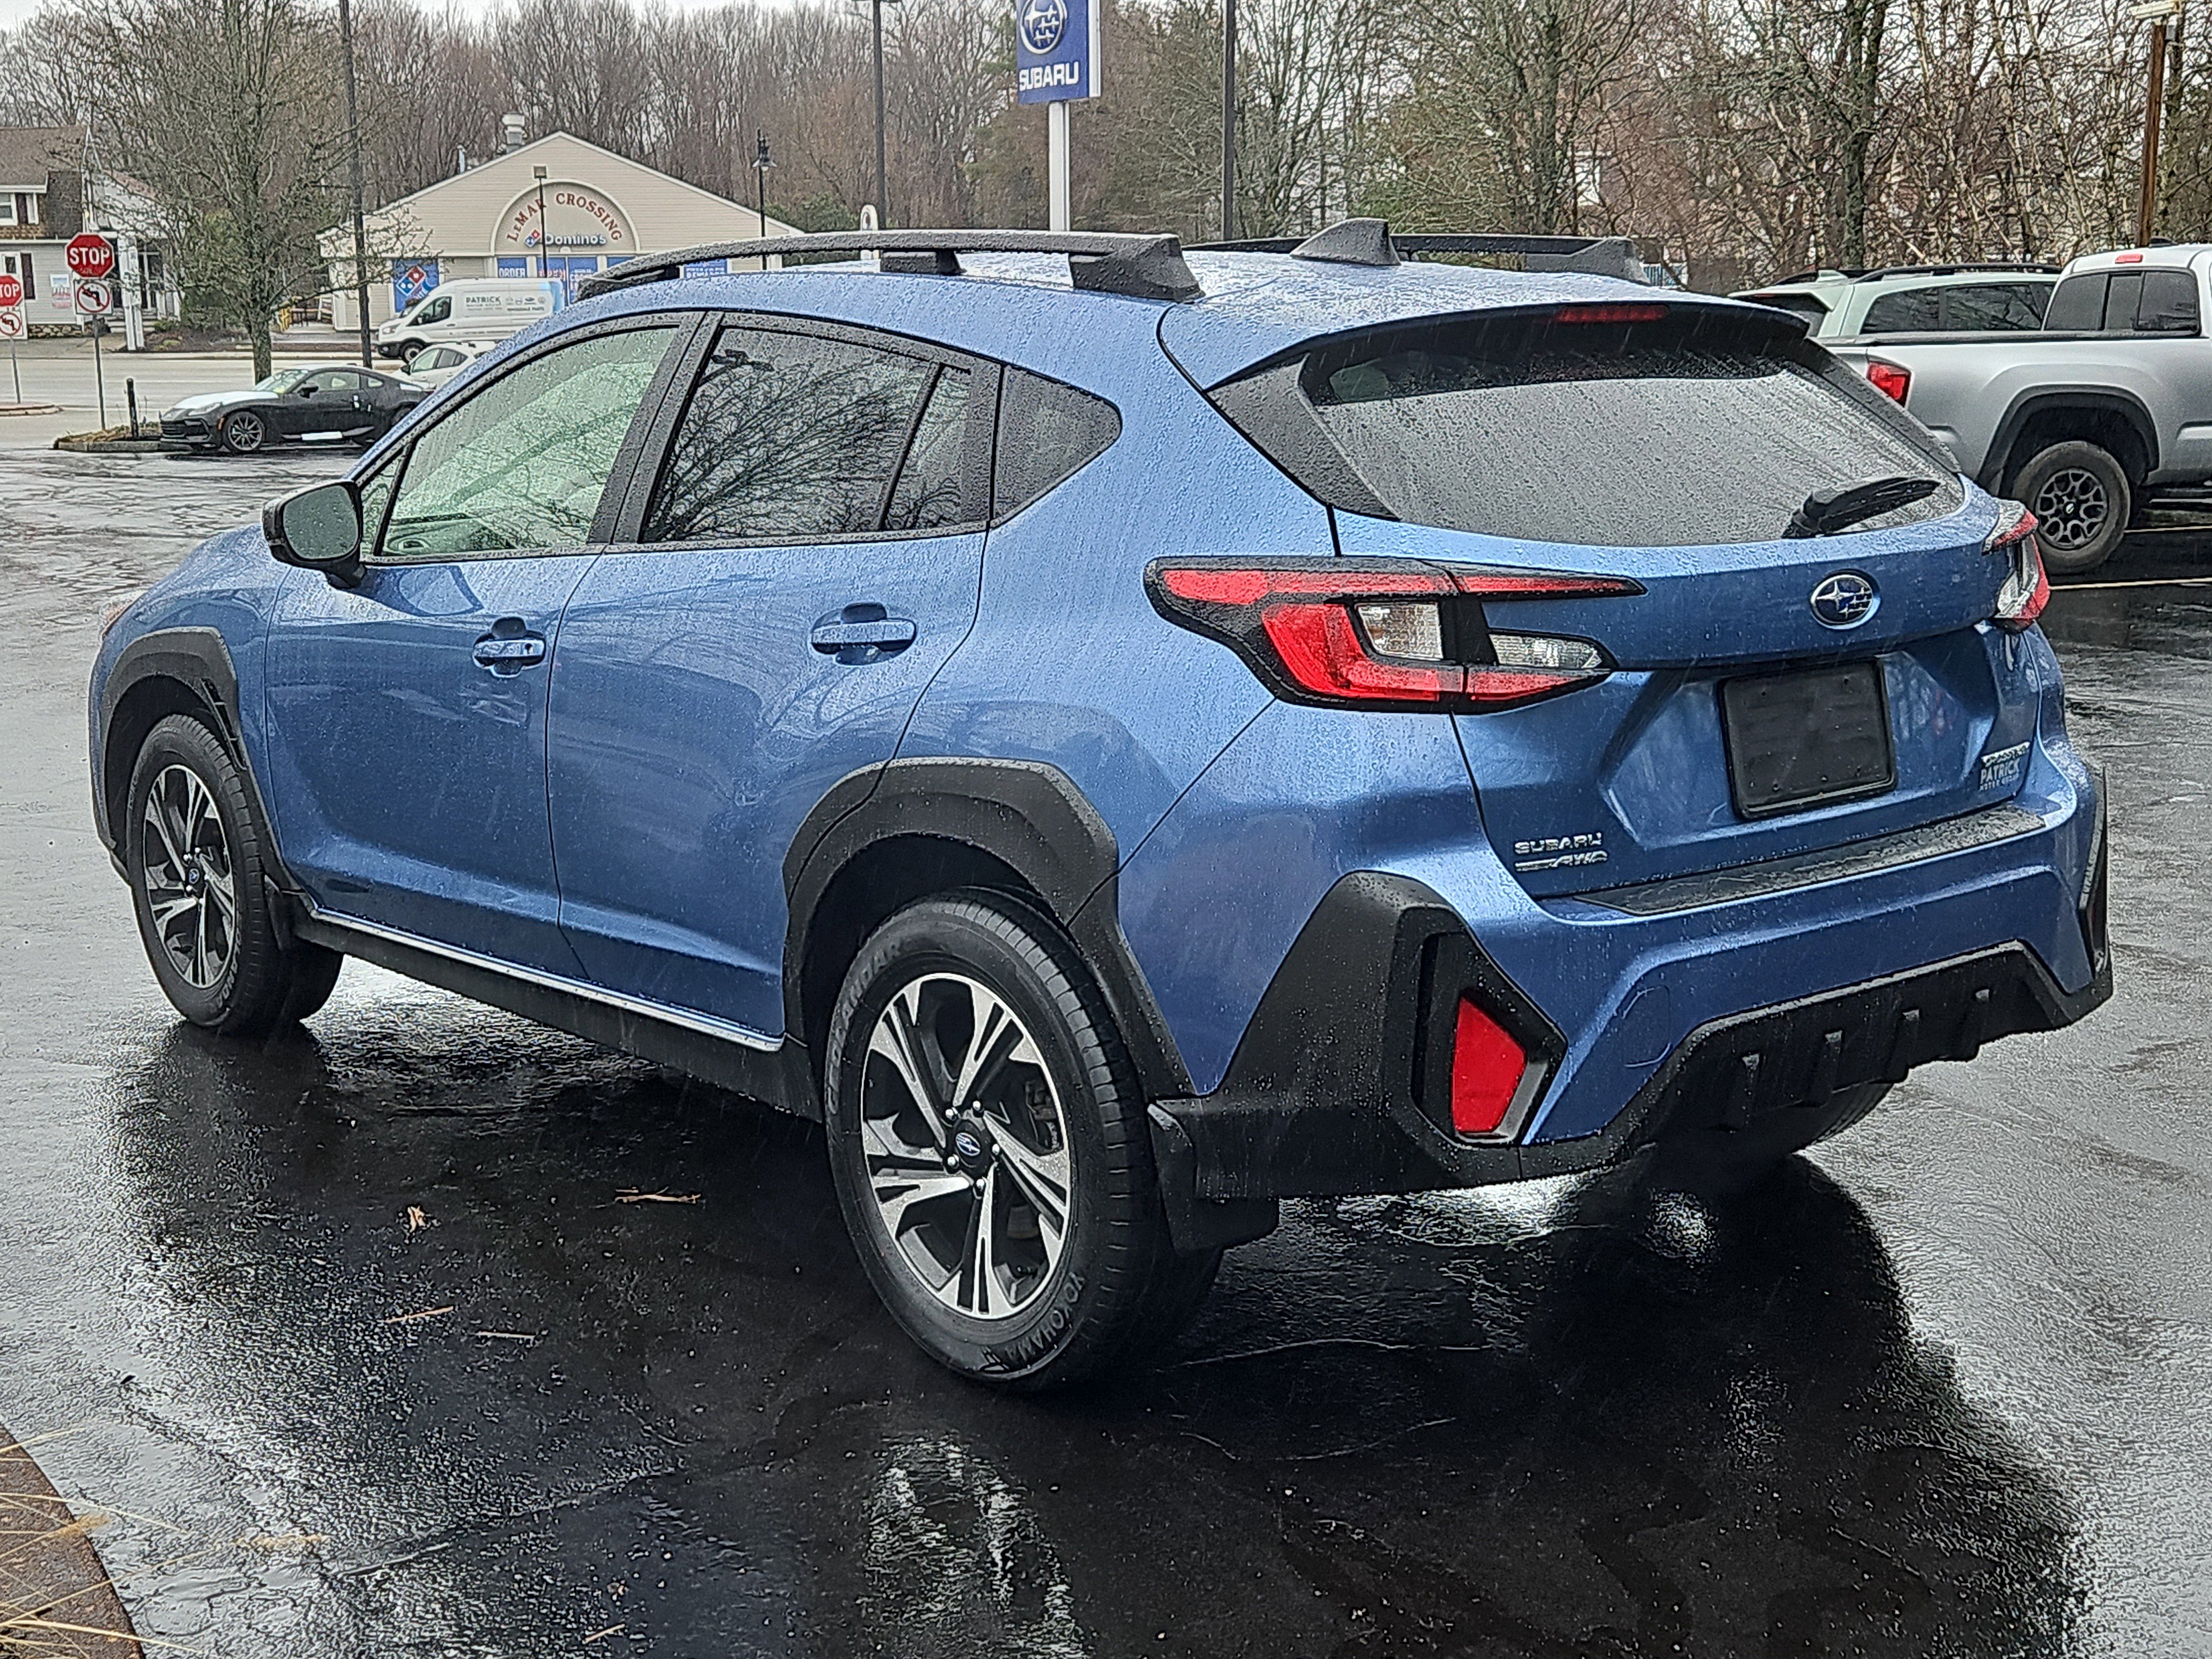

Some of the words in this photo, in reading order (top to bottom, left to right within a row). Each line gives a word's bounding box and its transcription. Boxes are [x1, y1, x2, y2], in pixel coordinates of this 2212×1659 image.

[1019, 61, 1079, 92] SUBARU
[556, 192, 622, 241] CROSSING
[545, 232, 606, 246] Domino's
[69, 247, 110, 266] STOP
[499, 267, 525, 278] ORDER
[466, 296, 501, 305] PATRICK
[1980, 757, 2021, 785] PATRICK
[1515, 832, 1602, 854] SUBARU
[1005, 1271, 1084, 1361] YOKOHAMA
